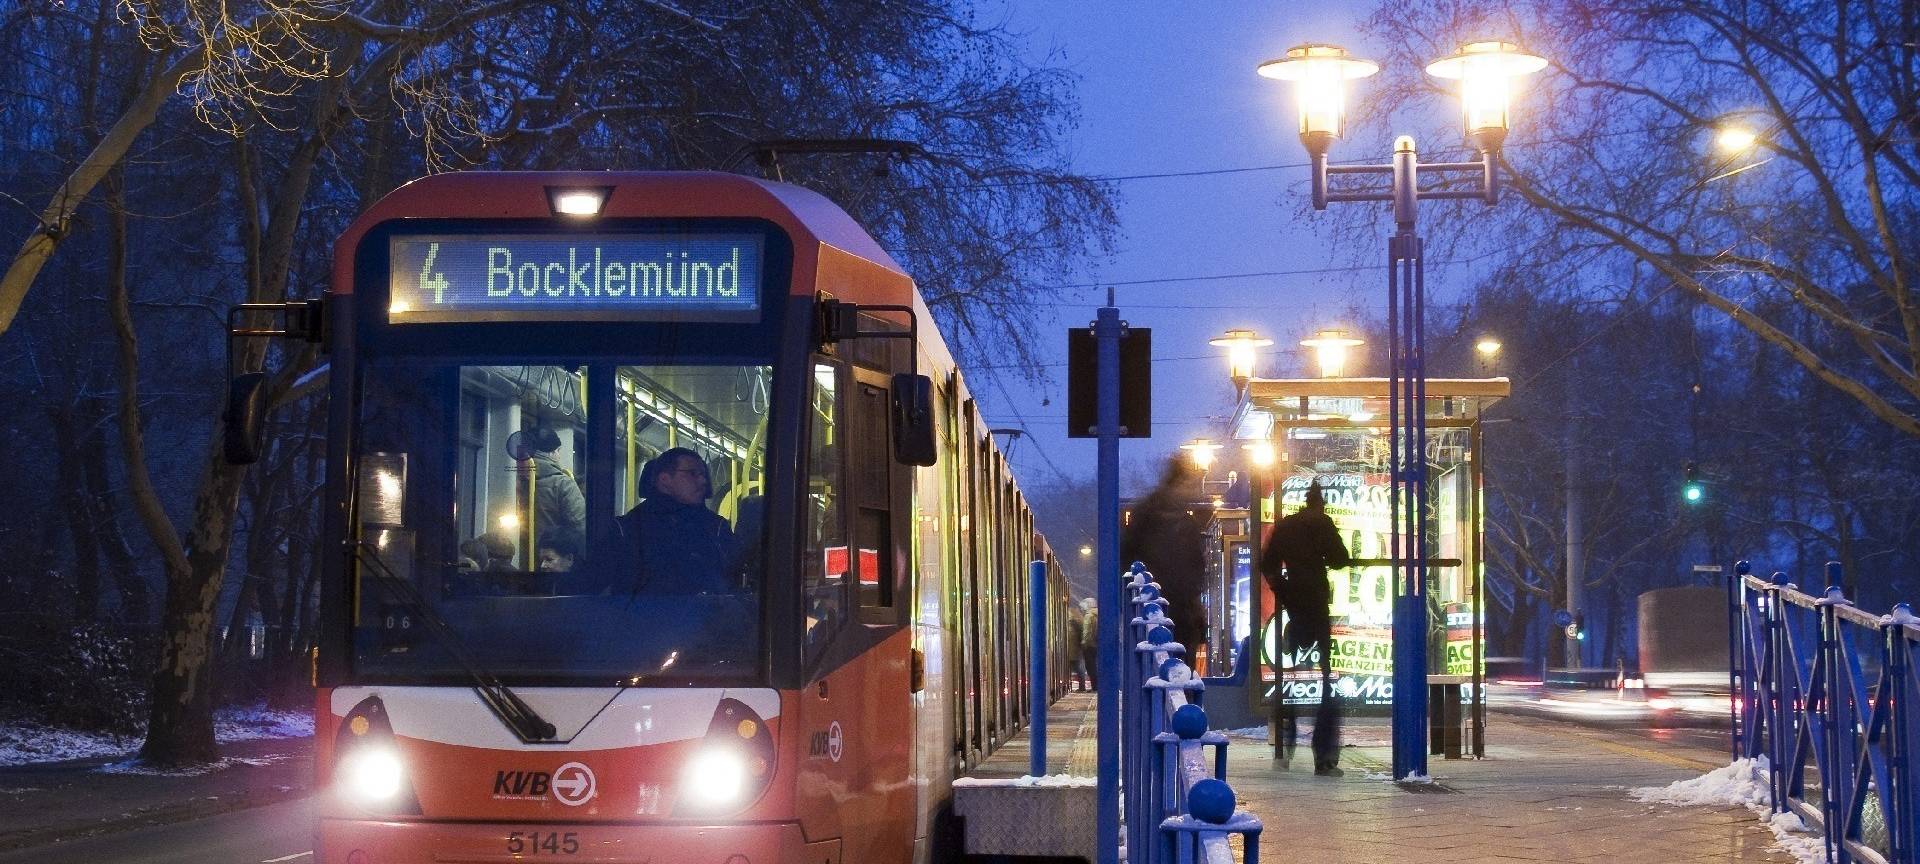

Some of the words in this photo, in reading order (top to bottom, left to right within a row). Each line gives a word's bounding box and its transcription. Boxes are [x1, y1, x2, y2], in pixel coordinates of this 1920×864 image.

[419, 242, 449, 304] 4
[487, 247, 739, 297] Bocklemünd
[1330, 638, 1393, 660] AGEN
[811, 731, 830, 755] KVB
[493, 771, 551, 796] KVB
[507, 831, 579, 855] 5145
